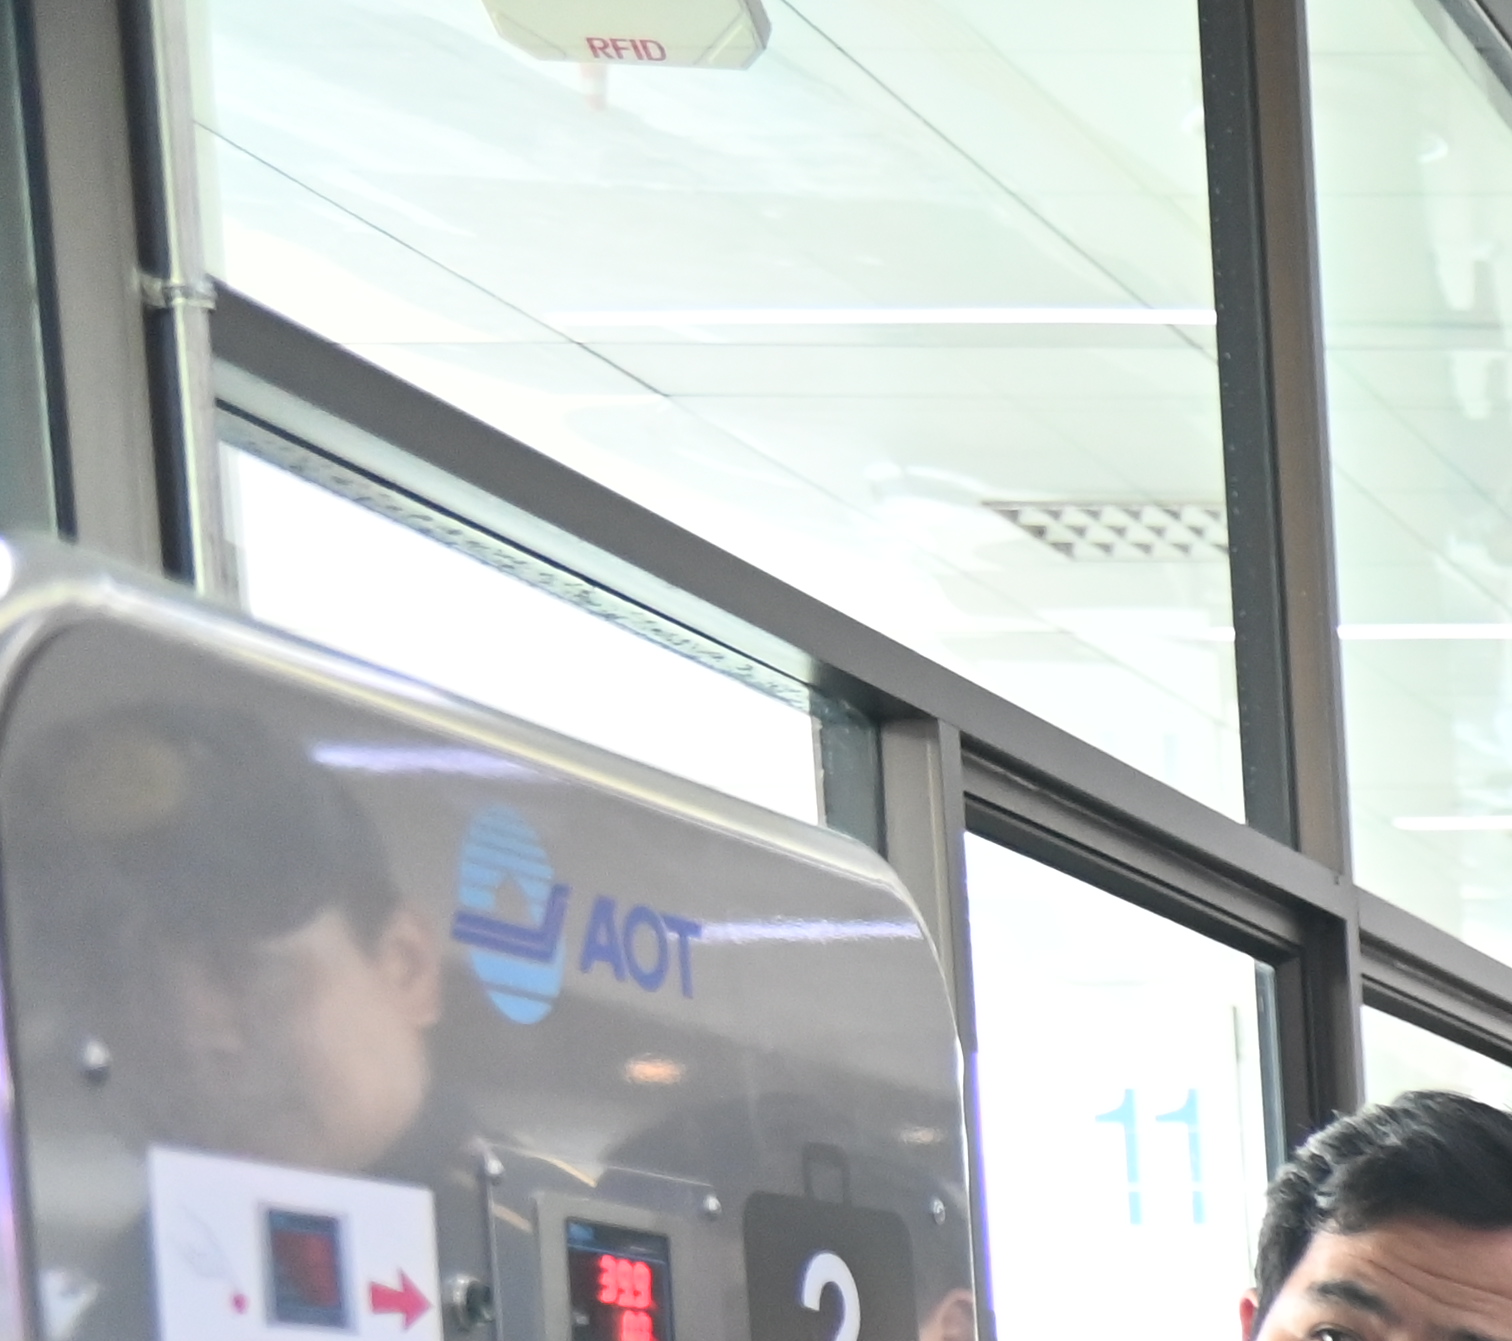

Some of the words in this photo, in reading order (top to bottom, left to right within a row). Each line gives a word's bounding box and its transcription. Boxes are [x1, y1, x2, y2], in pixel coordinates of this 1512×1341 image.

[586, 37, 667, 62] RFID
[580, 893, 702, 998] AOT
[1095, 1088, 1206, 1225] 11
